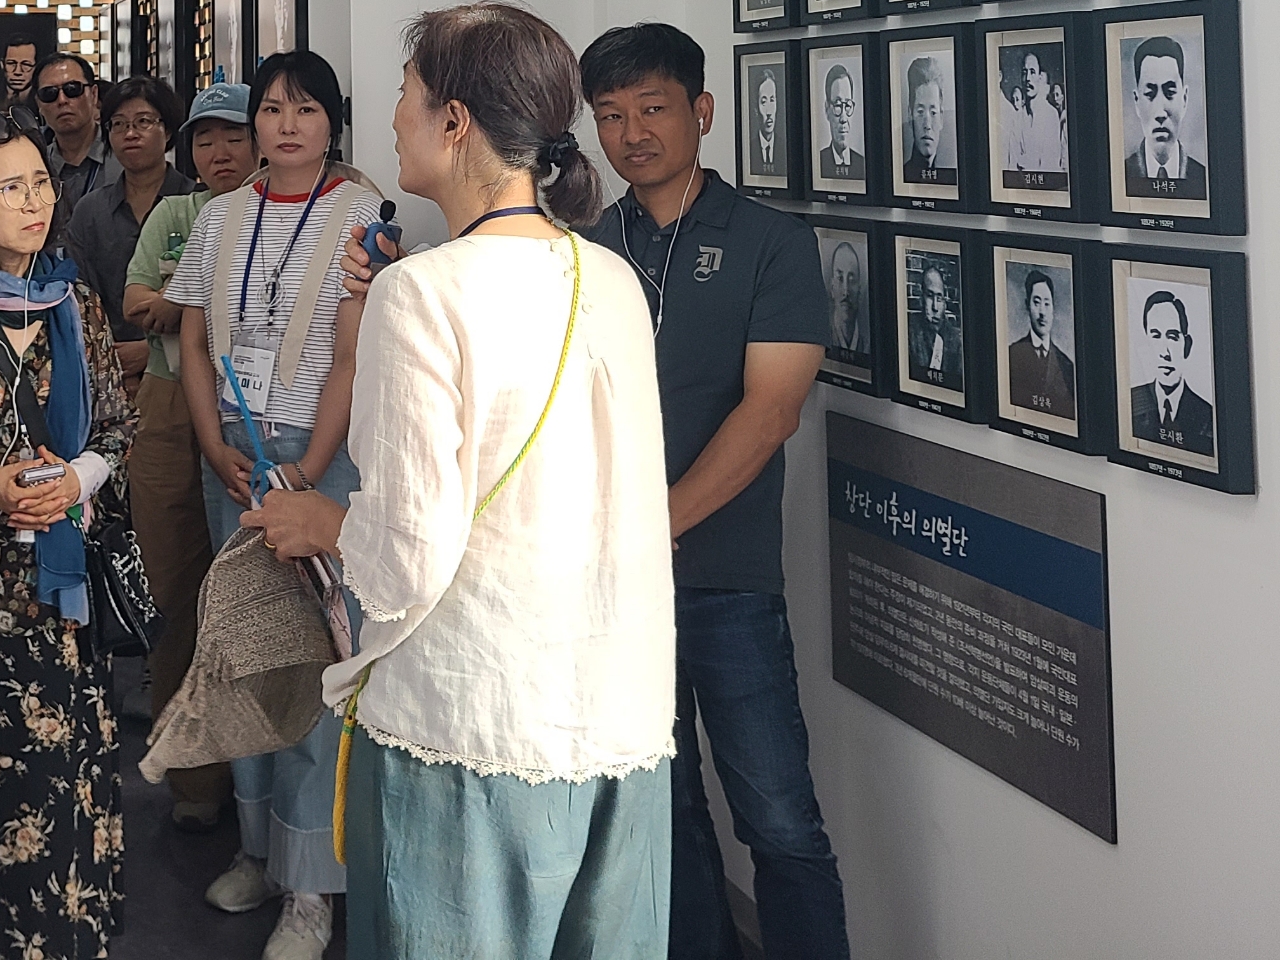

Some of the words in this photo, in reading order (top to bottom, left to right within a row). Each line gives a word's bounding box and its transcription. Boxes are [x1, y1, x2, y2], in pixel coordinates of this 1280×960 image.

[1024, 173, 1044, 185] 김시현
[1152, 180, 1177, 193] 나석주
[1031, 394, 1052, 409] 김상옥
[1158, 427, 1184, 445] 문시환
[845, 480, 872, 518] 창단
[876, 491, 916, 536] 이후의
[921, 515, 969, 557] 의열단
[934, 646, 942, 660] 그
[1000, 619, 1014, 637] 국민
[1014, 625, 1040, 649] 대표들이
[1040, 637, 1055, 656] 모인
[1056, 644, 1077, 666] 가운데
[977, 628, 996, 648] 과정을
[996, 637, 1010, 655] 거쳐
[1010, 643, 1032, 665] 1923년
[1050, 661, 1077, 687] 국민대표
[1057, 686, 1078, 710] 운동의
[1015, 706, 1029, 725] 크게
[1030, 713, 1050, 736] 늘어나
[1050, 724, 1064, 744] 단원
[1065, 732, 1080, 752] 수가
